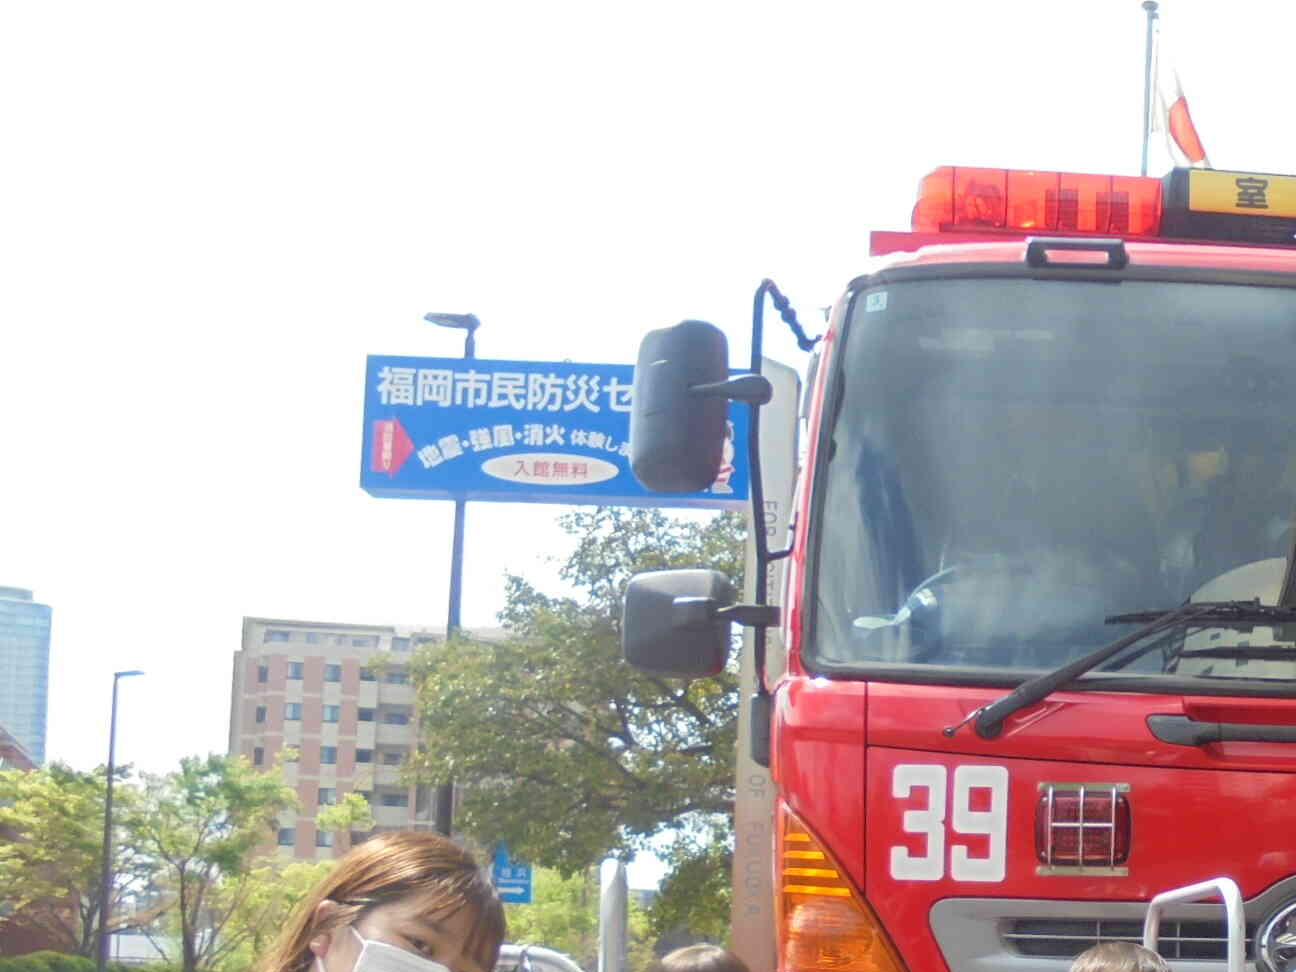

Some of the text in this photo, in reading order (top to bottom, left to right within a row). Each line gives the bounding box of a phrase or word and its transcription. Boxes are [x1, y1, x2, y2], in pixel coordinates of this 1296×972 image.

[377, 366, 634, 413] 福岡市民防災セ
[513, 460, 589, 478] 入館無料
[890, 764, 1009, 882] 39
